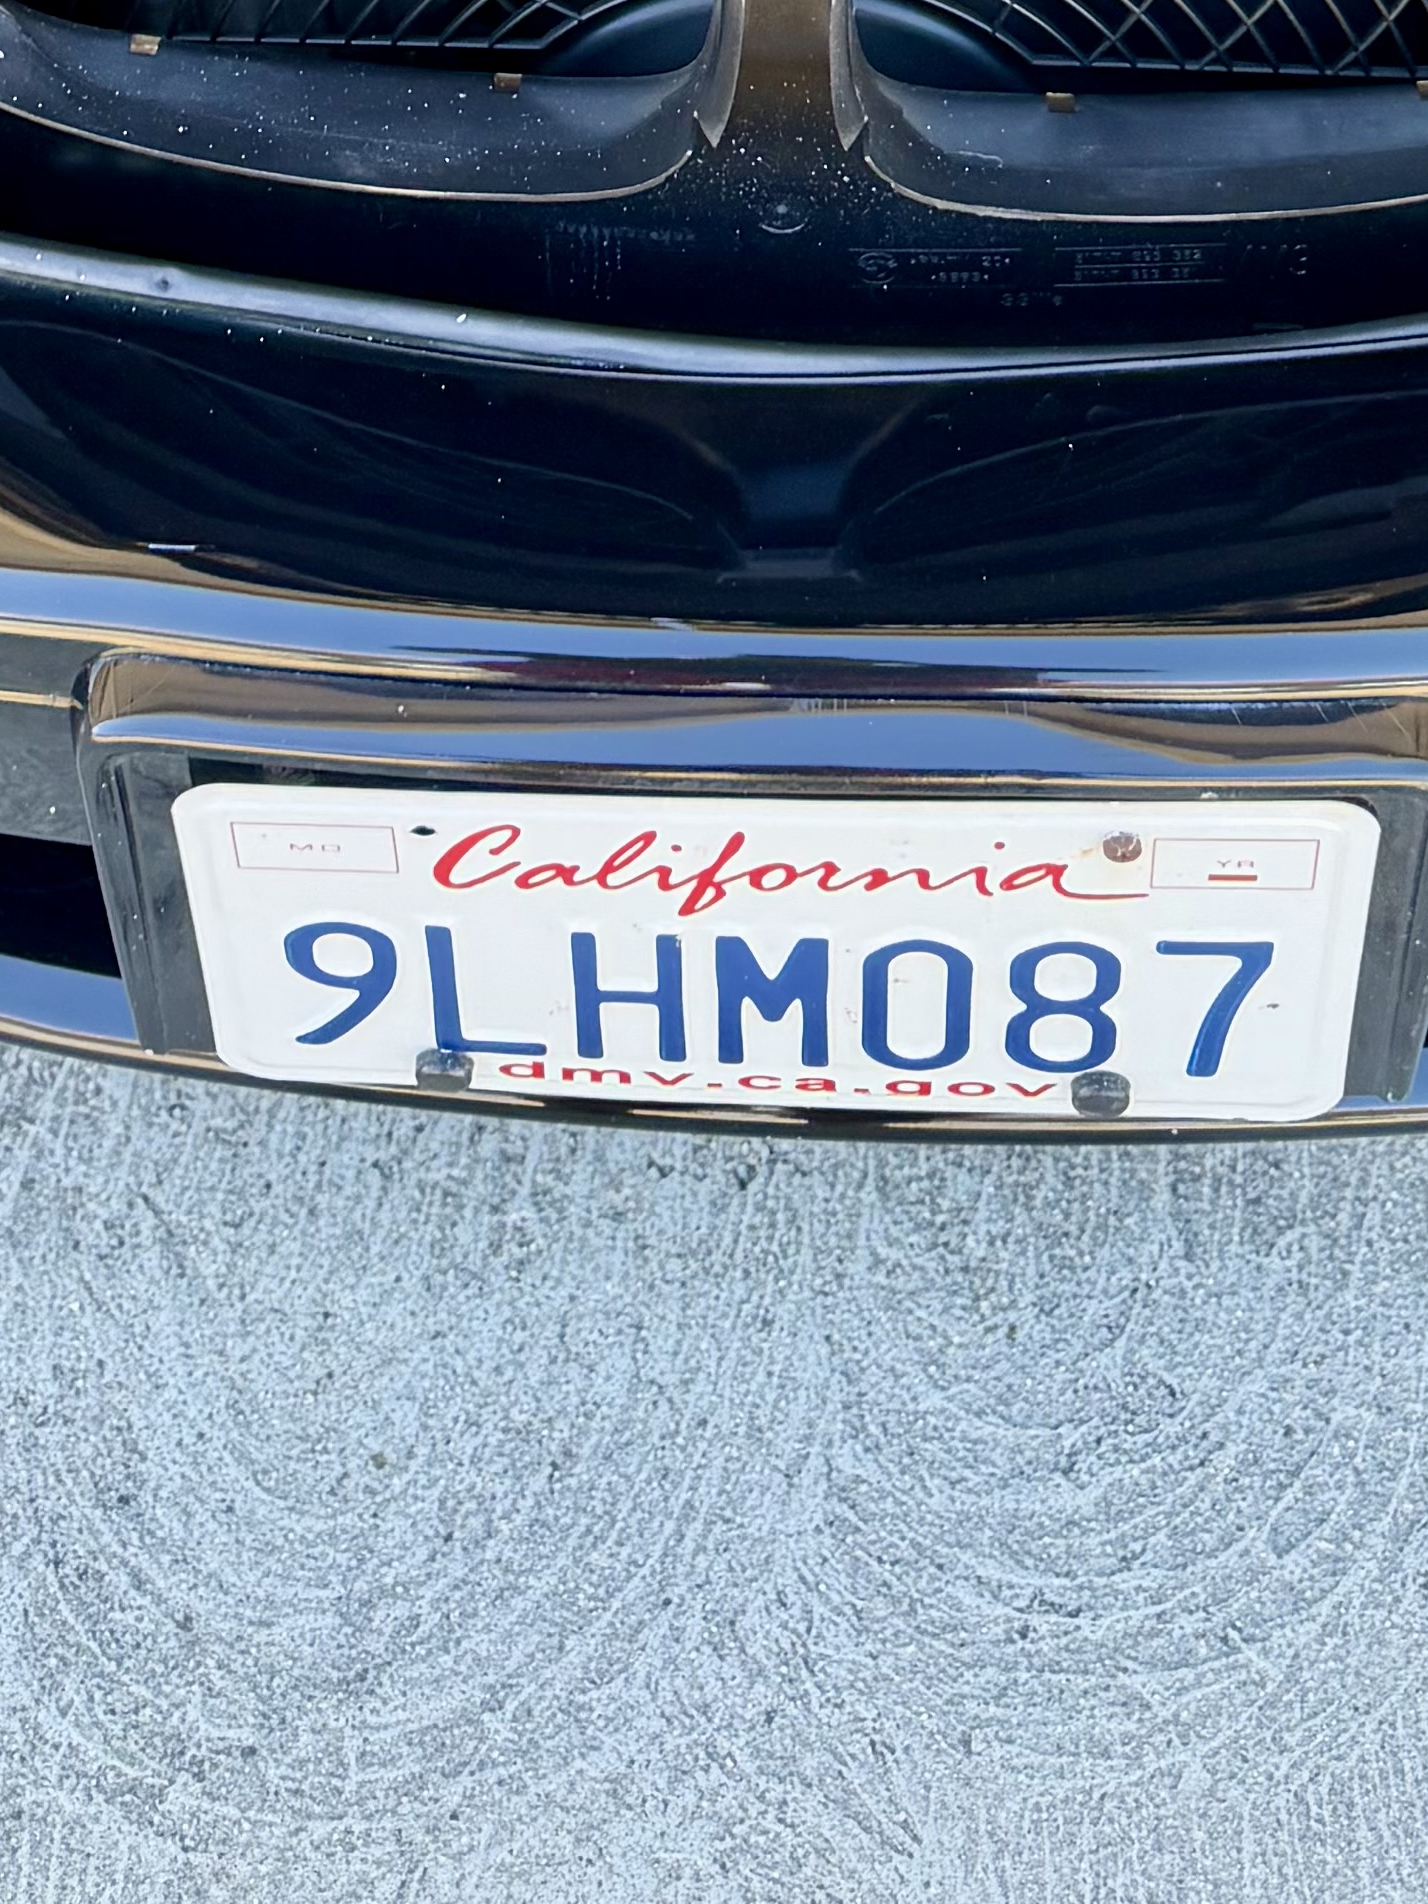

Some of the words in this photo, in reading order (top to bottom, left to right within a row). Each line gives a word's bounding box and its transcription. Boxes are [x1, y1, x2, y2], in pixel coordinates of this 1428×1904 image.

[289, 841, 342, 854] MO
[432, 823, 1149, 918] California
[1215, 859, 1255, 869] YR
[283, 921, 1275, 1078] 9LHM087
[498, 1060, 1057, 1097] dmv.ca.gov
